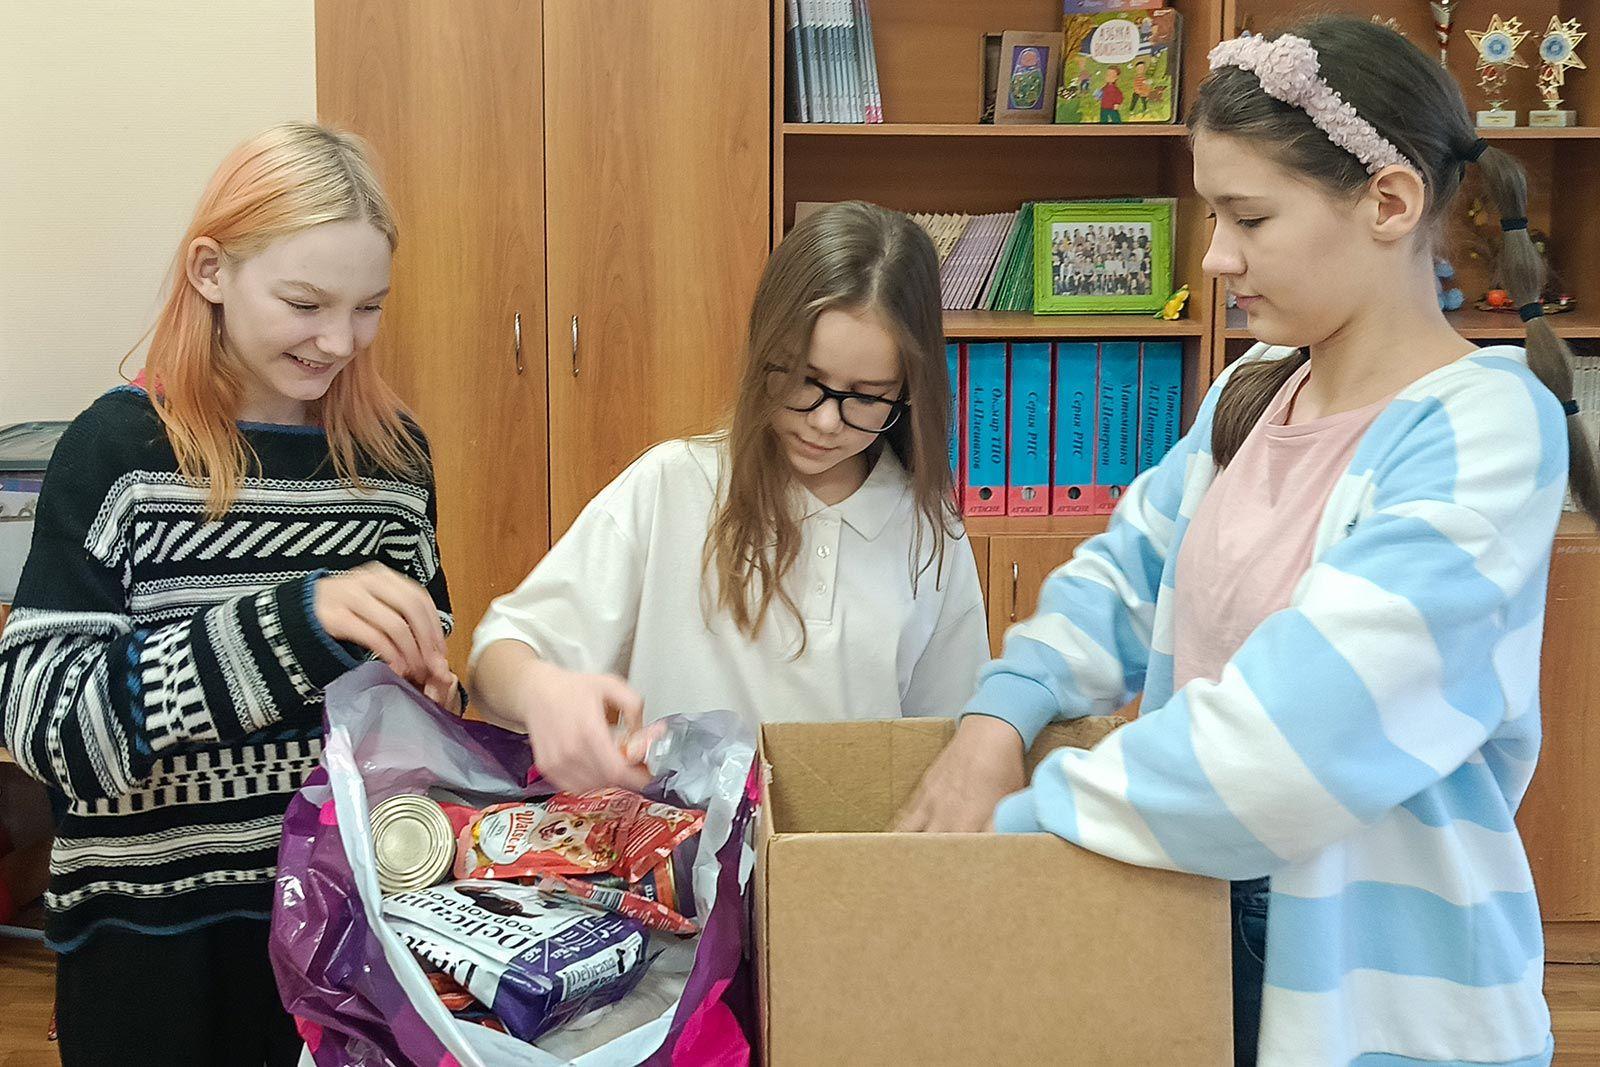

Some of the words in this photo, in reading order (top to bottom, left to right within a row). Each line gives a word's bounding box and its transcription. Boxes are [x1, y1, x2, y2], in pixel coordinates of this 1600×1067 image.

[1025, 391, 1038, 428] Серия
[1071, 391, 1084, 428] Серия
[1120, 382, 1132, 466] Математика
[1164, 383, 1179, 456] Математи
[419, 889, 456, 907] DOG
[457, 904, 493, 921] FOR
[494, 917, 543, 937] FOOD
